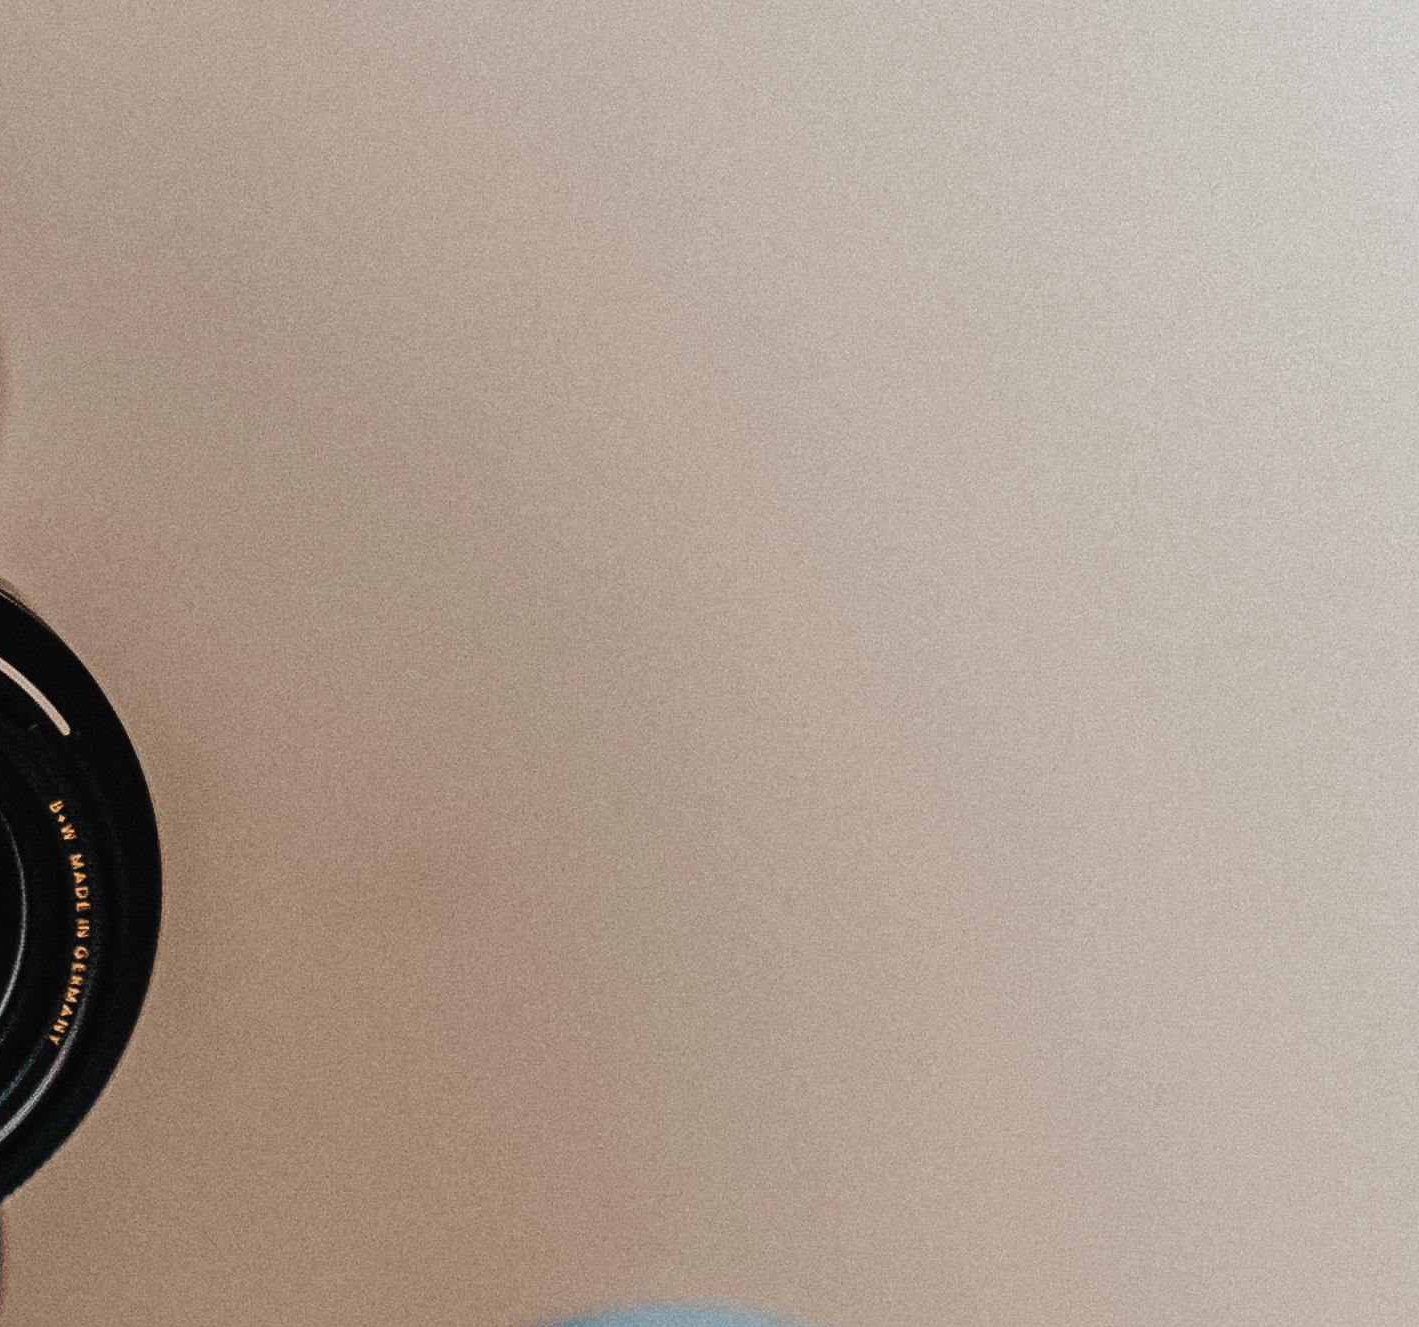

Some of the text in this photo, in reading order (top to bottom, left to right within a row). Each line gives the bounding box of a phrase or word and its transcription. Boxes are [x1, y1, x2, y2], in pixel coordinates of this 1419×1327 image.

[68, 852, 91, 912] MADE
[75, 918, 90, 939] IN
[48, 945, 90, 1046] GERMANY
